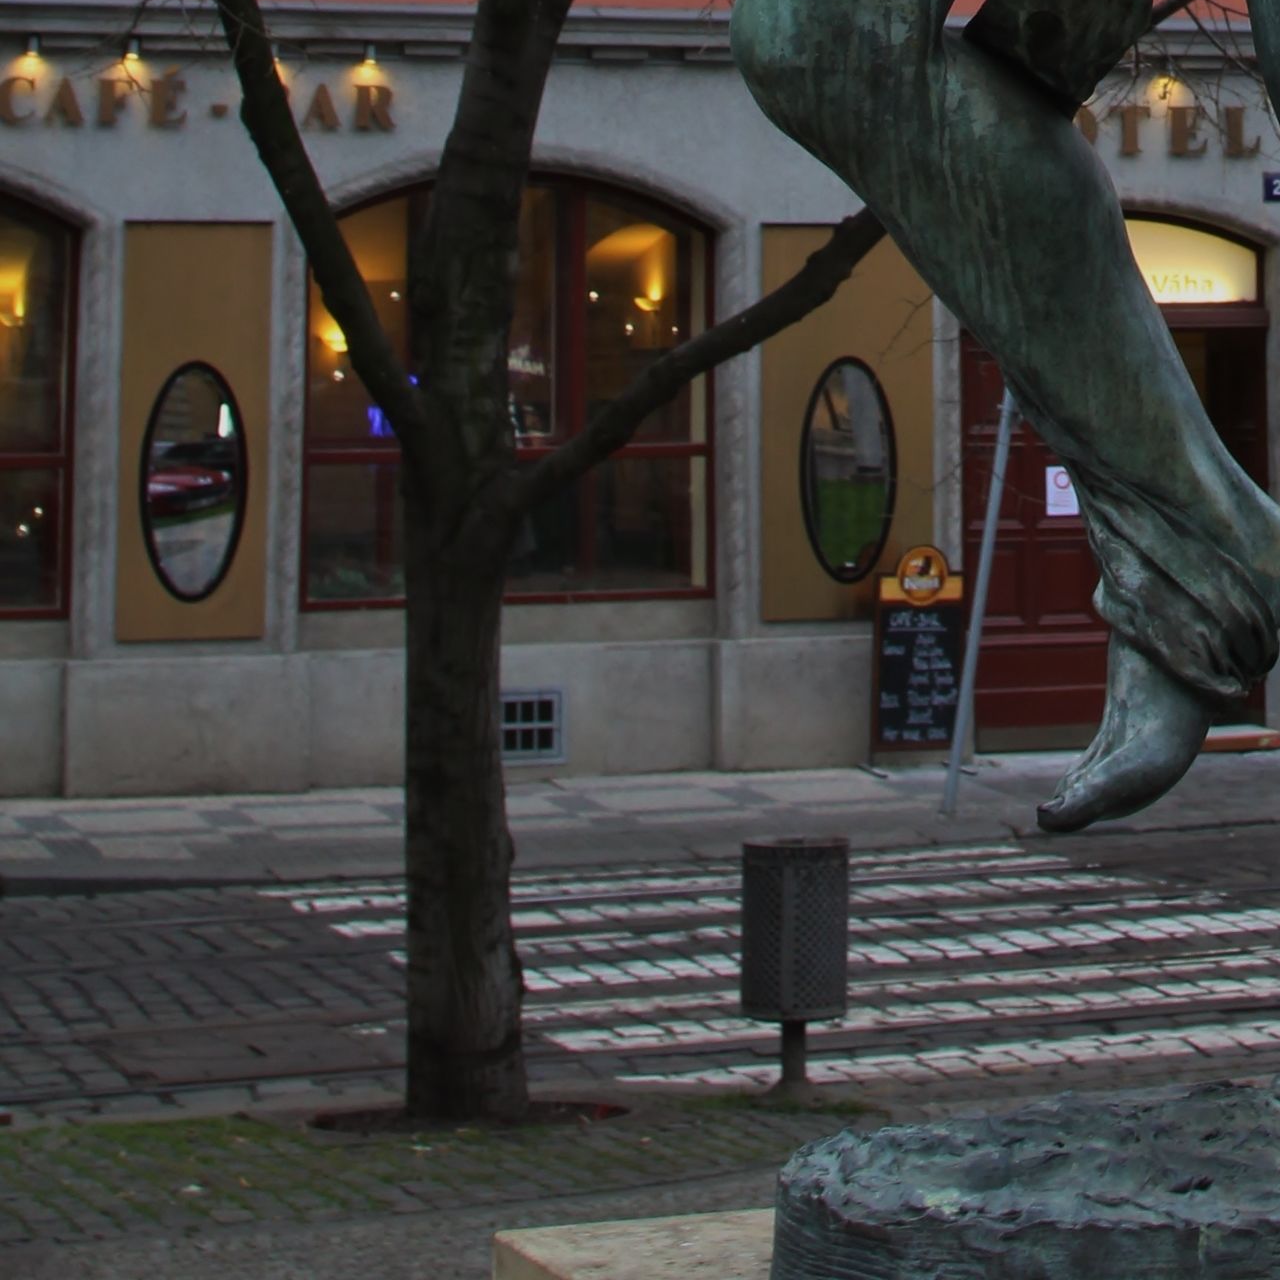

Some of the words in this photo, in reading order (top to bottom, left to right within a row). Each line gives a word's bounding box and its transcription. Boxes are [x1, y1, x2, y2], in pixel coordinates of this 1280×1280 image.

[0, 65, 187, 127] CAFÉ
[284, 83, 397, 131] AR
[1151, 271, 1213, 293] Váha
